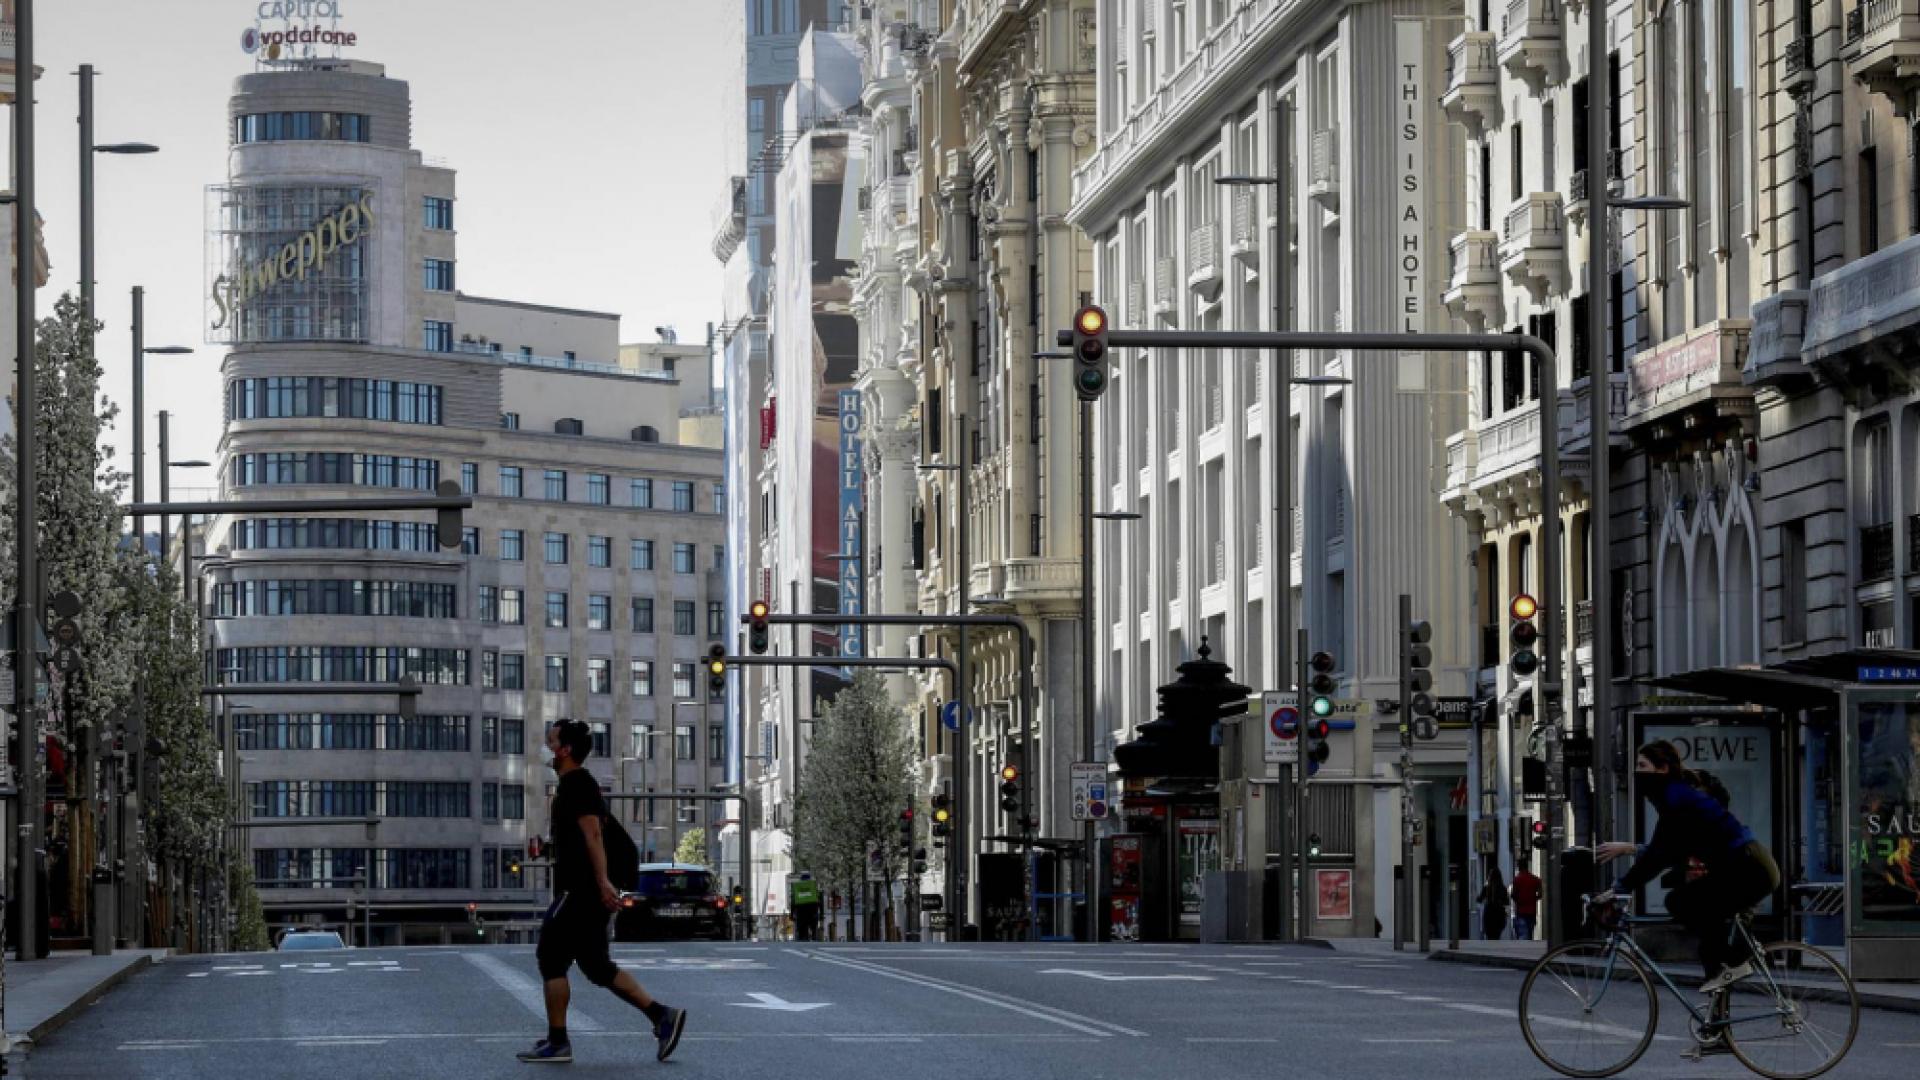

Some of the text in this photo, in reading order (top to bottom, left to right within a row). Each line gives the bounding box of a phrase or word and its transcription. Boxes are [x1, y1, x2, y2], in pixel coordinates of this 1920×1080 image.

[258, 0, 343, 19] CAPITOL
[261, 25, 357, 46] vodafone
[1402, 64, 1419, 333] THIS IS A HOTEL
[211, 189, 376, 330] Schweppes
[842, 394, 858, 489] HOTEL
